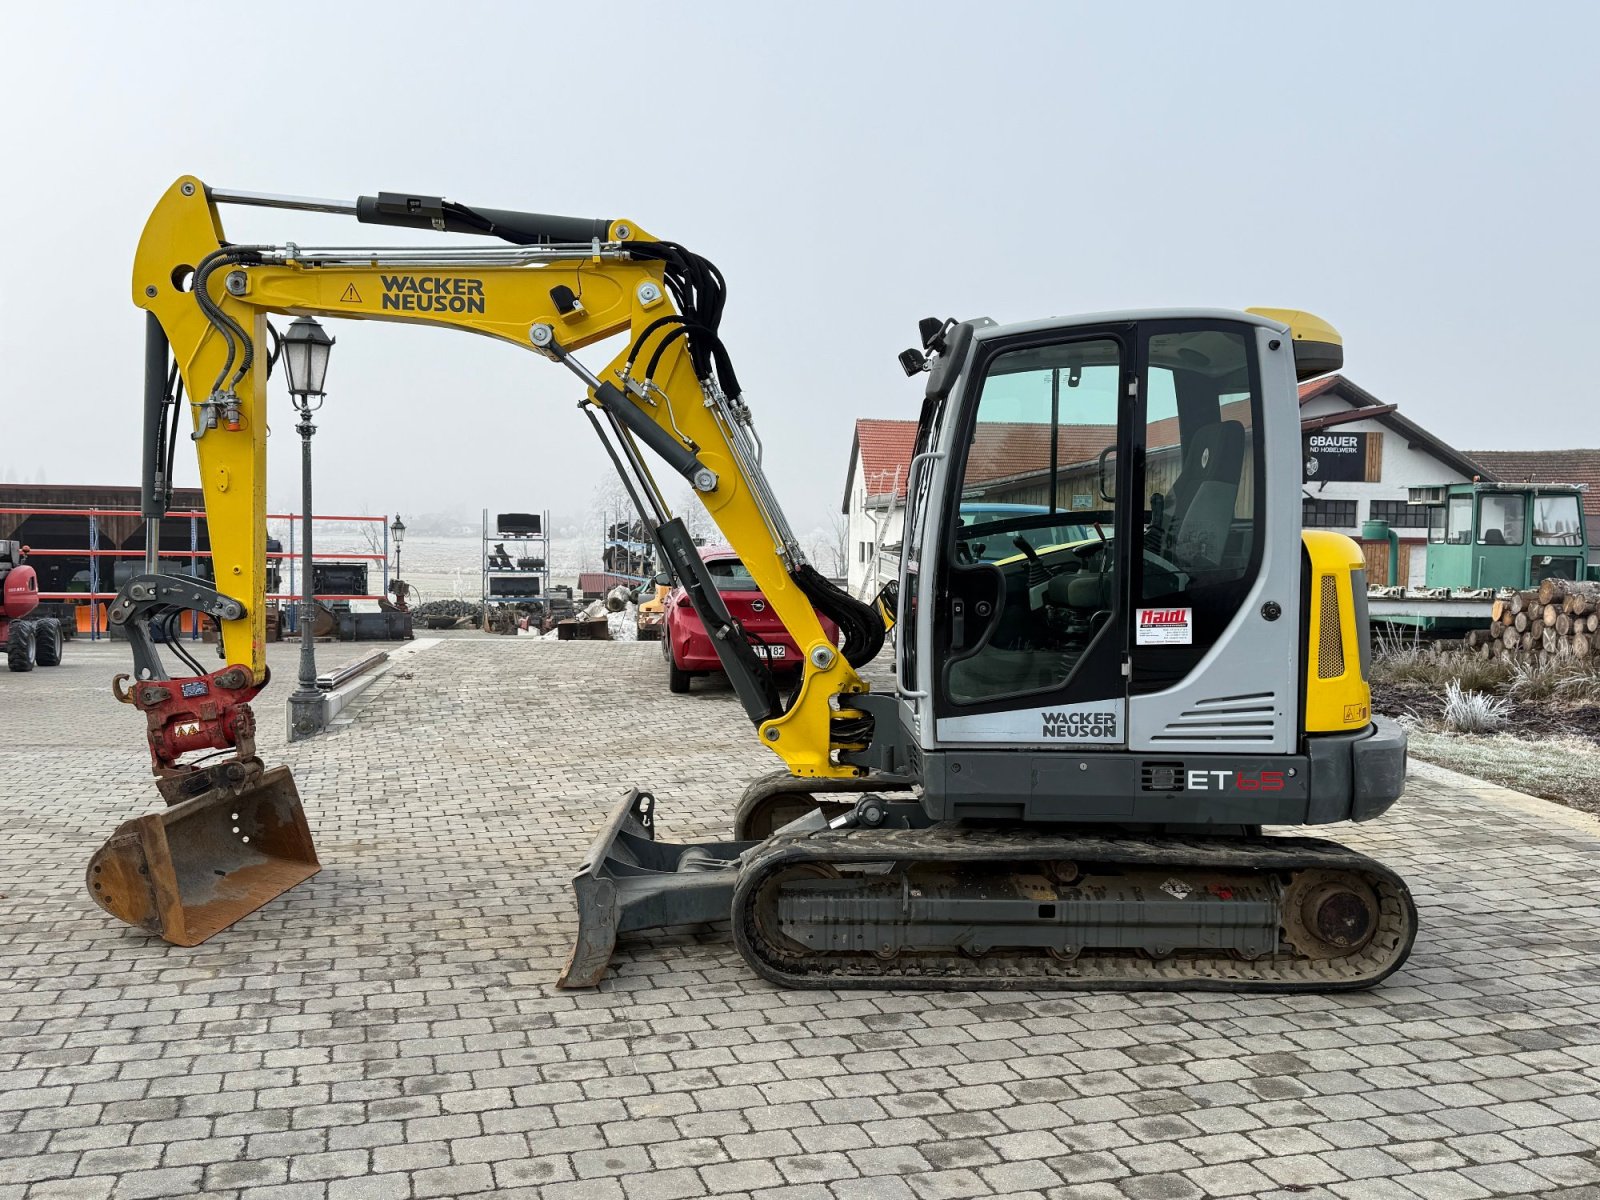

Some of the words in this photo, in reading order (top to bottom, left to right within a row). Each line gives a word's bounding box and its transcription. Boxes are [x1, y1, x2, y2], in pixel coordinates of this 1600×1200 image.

[380, 275, 485, 296] WACKER
[382, 293, 485, 314] NEUSON
[1309, 435, 1358, 447] GBAUER
[773, 646, 785, 656] 82
[1041, 712, 1117, 725] WACKER
[1042, 725, 1117, 737] NEUSON
[1187, 770, 1286, 791] ET65
